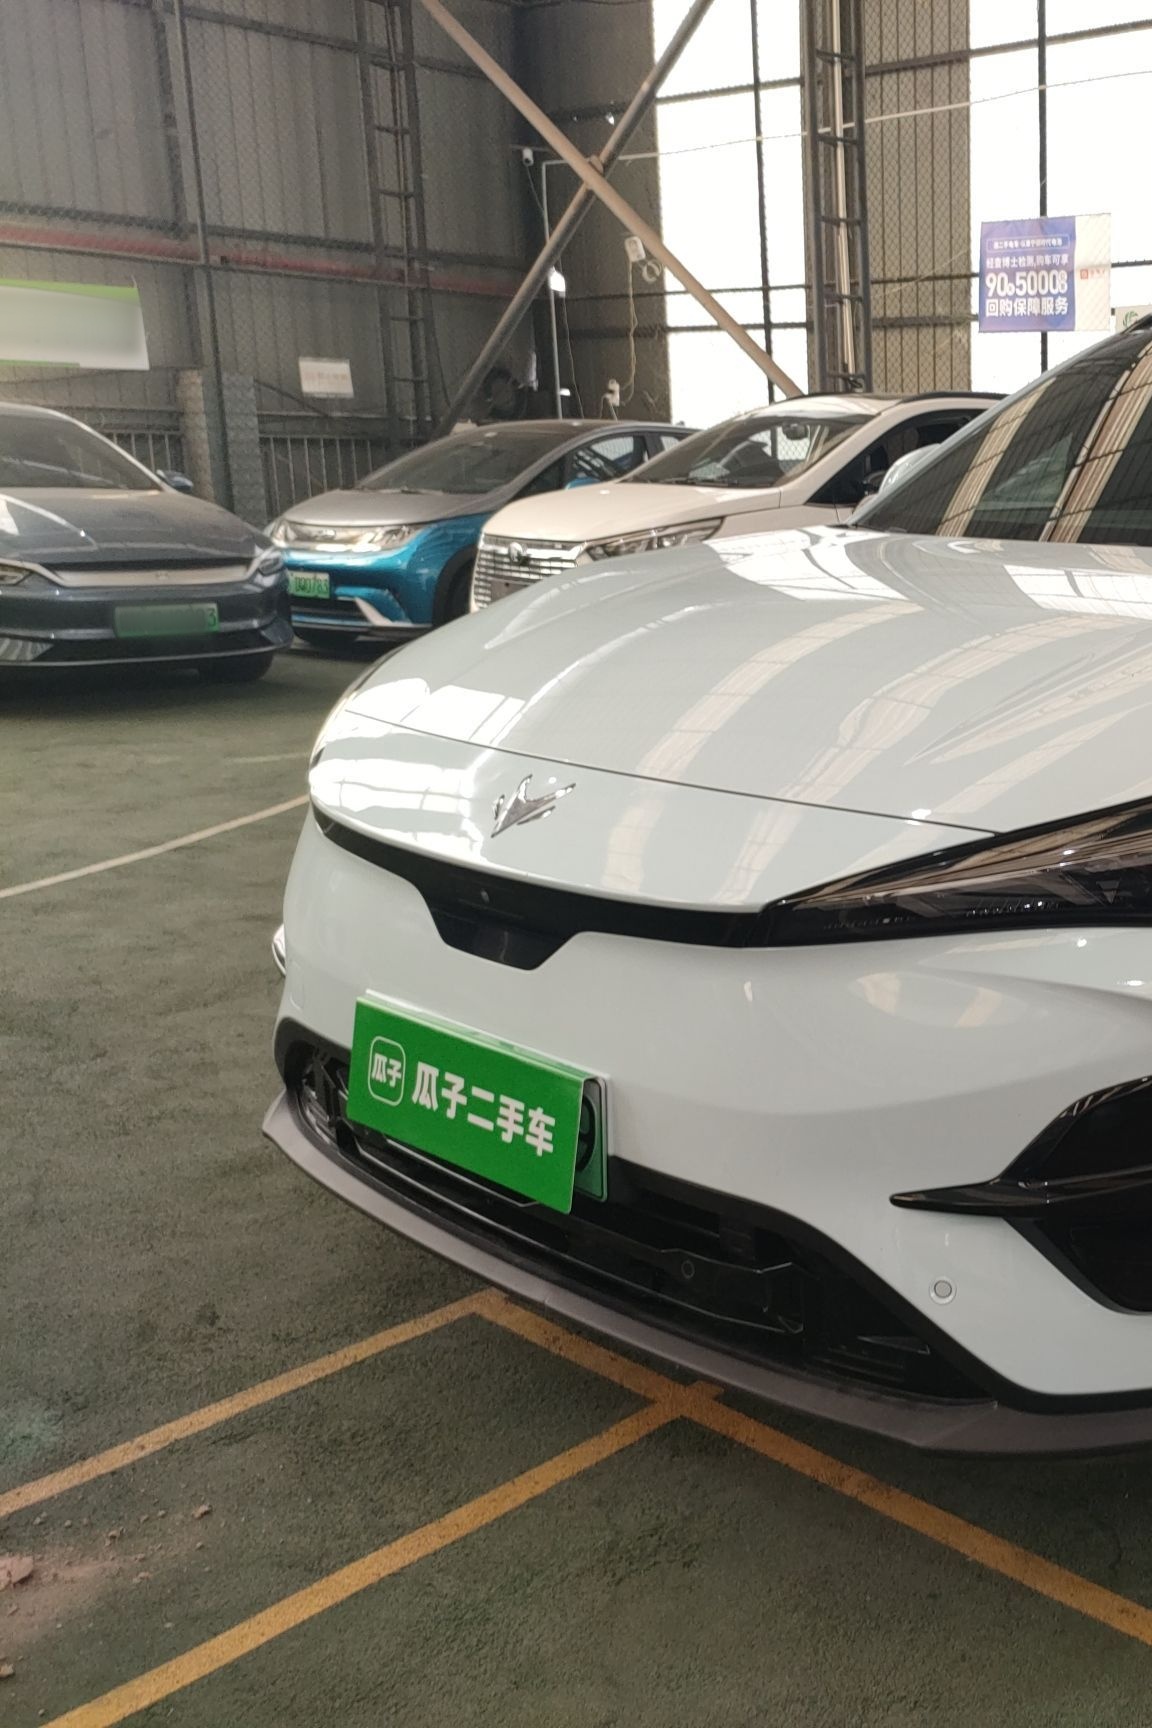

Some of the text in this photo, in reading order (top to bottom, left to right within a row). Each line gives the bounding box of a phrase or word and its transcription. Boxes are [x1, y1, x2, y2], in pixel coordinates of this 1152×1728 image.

[985, 297, 1069, 317] 回购保障服务
[371, 1053, 402, 1088] 瓜子
[411, 1061, 556, 1157] 瓜子二手车
